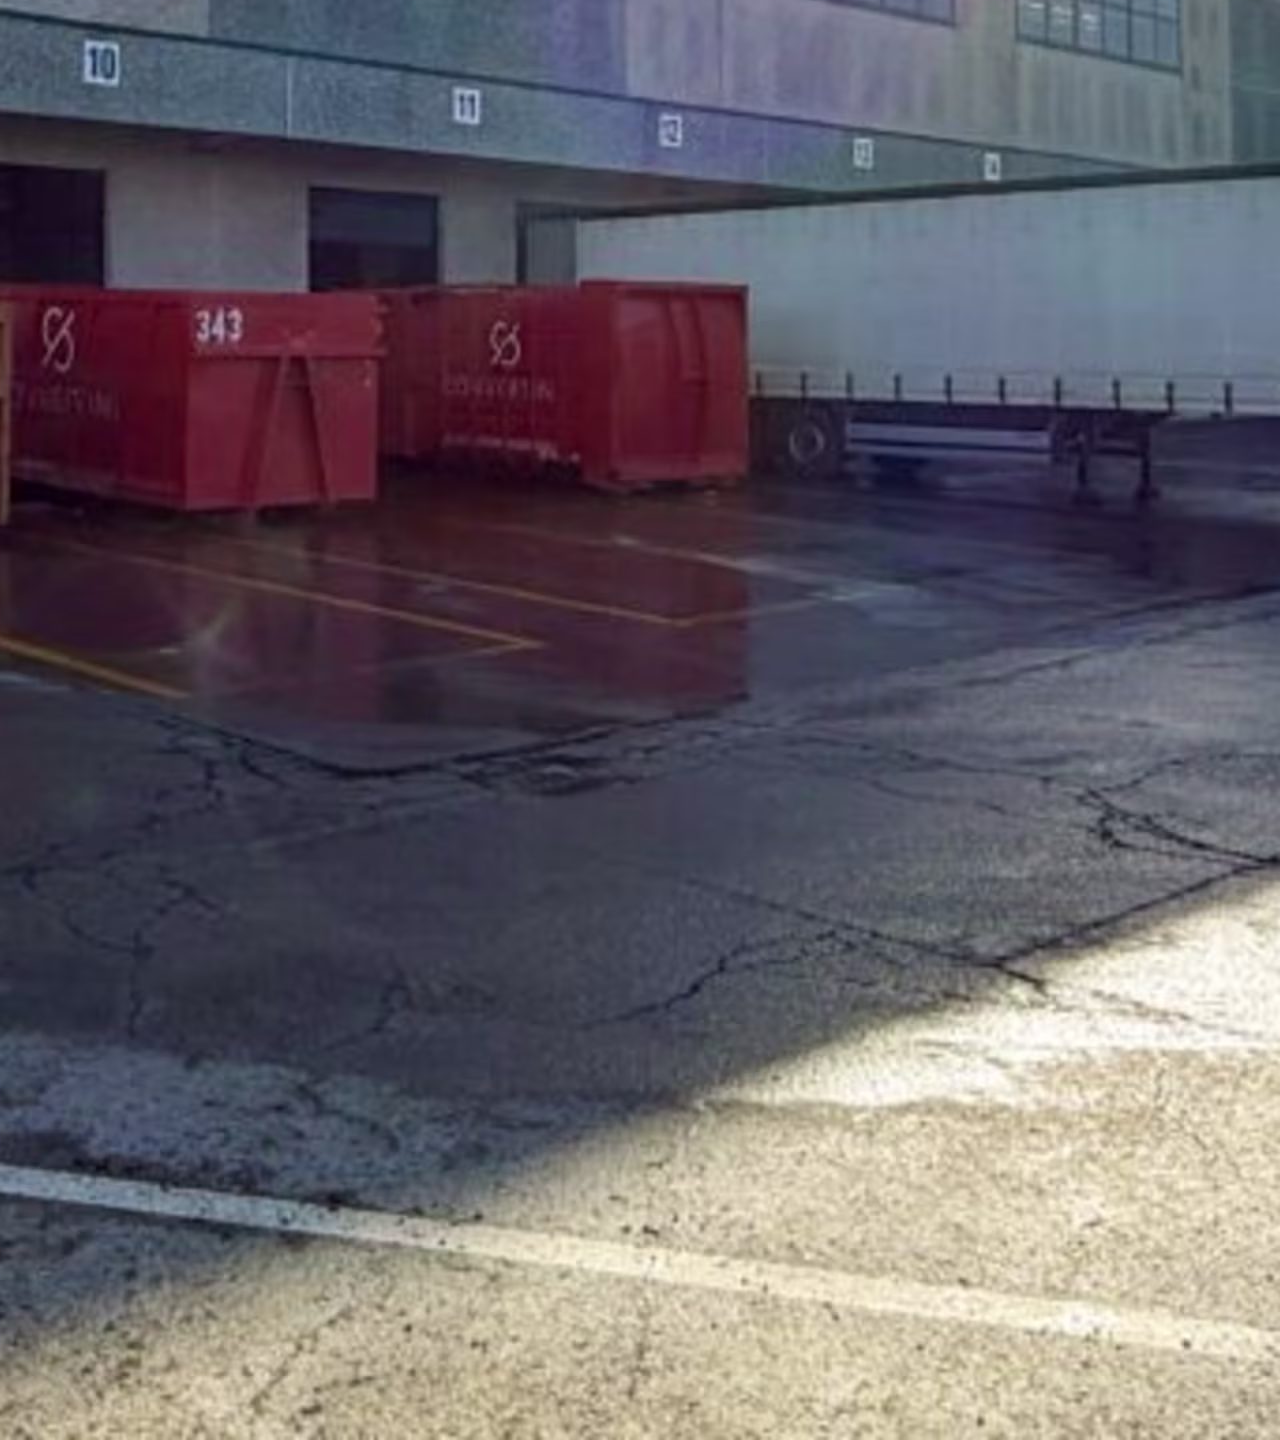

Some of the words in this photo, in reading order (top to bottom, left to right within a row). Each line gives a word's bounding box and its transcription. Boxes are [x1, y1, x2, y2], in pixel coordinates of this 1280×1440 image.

[89, 46, 116, 79] 10
[458, 92, 476, 118] 11
[195, 307, 244, 344] 343
